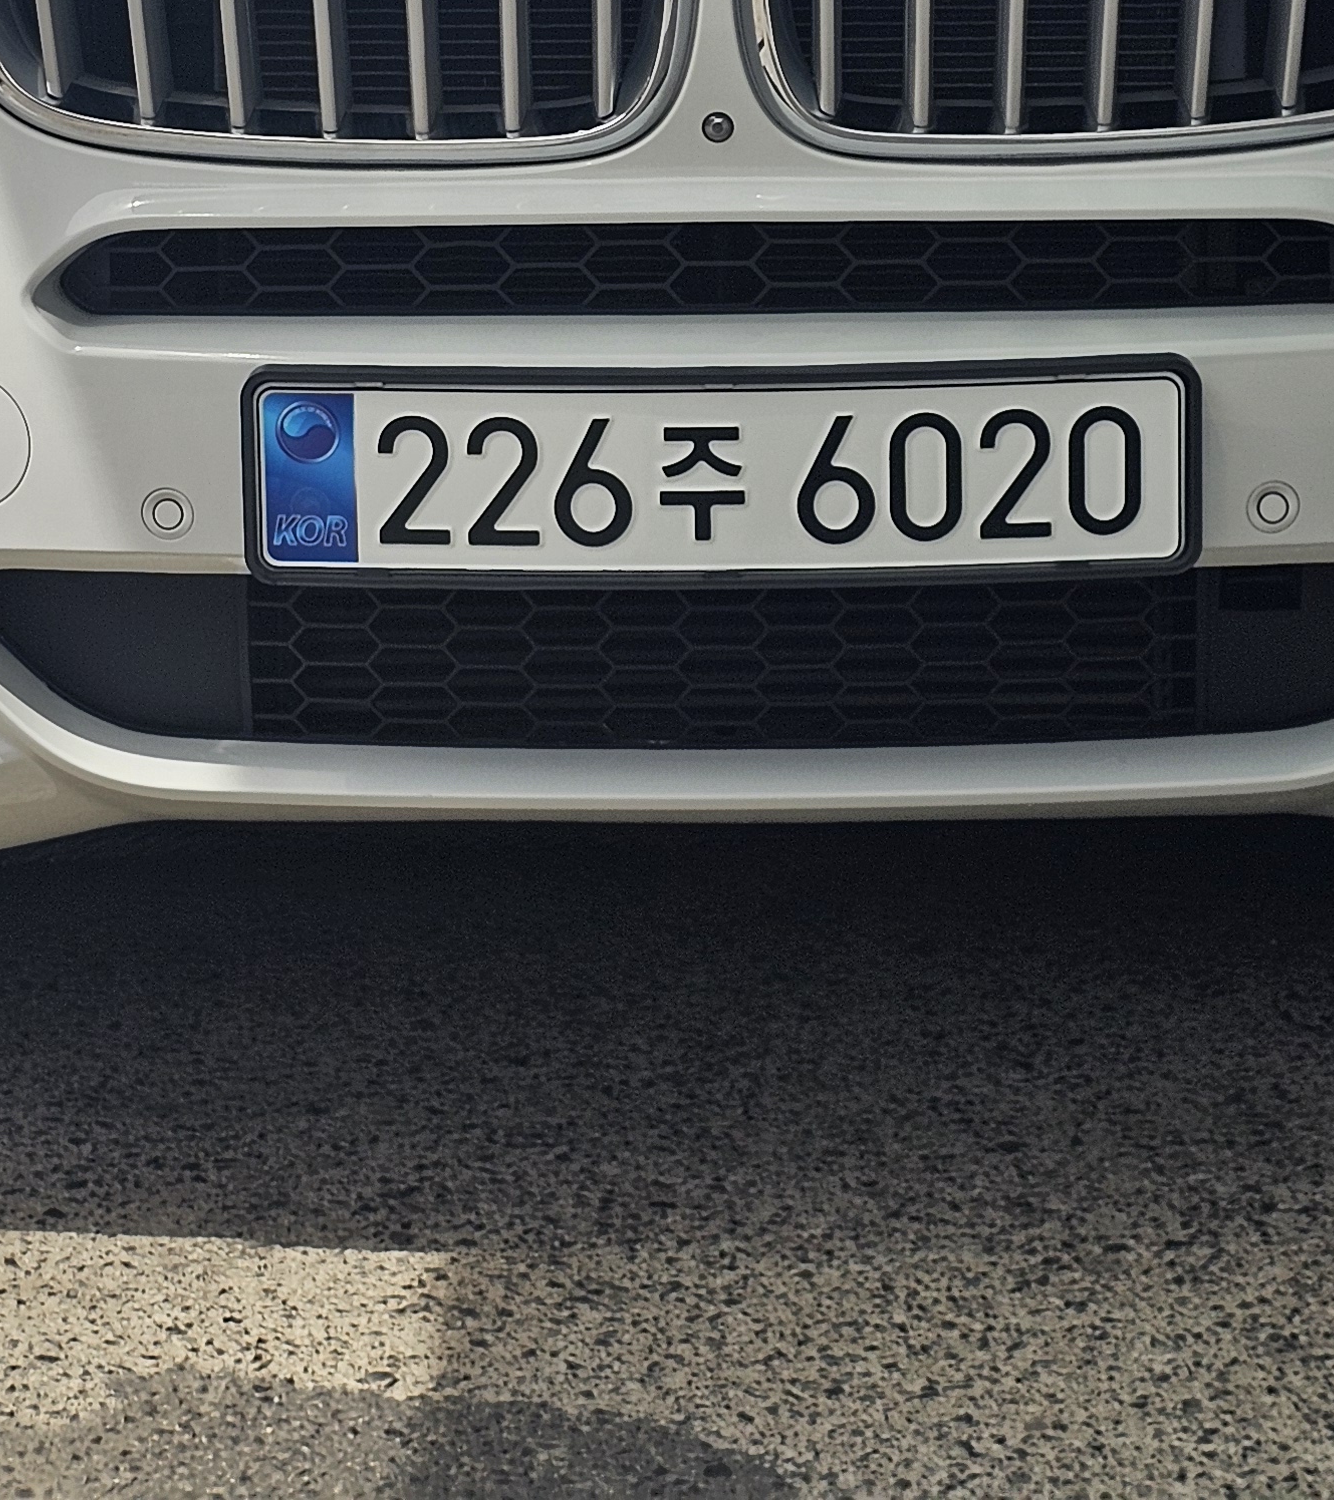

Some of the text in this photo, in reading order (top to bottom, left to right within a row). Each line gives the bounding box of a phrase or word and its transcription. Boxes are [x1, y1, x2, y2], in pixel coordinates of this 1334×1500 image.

[377, 405, 1142, 548] 226주 6020
[272, 513, 349, 547] KOR
